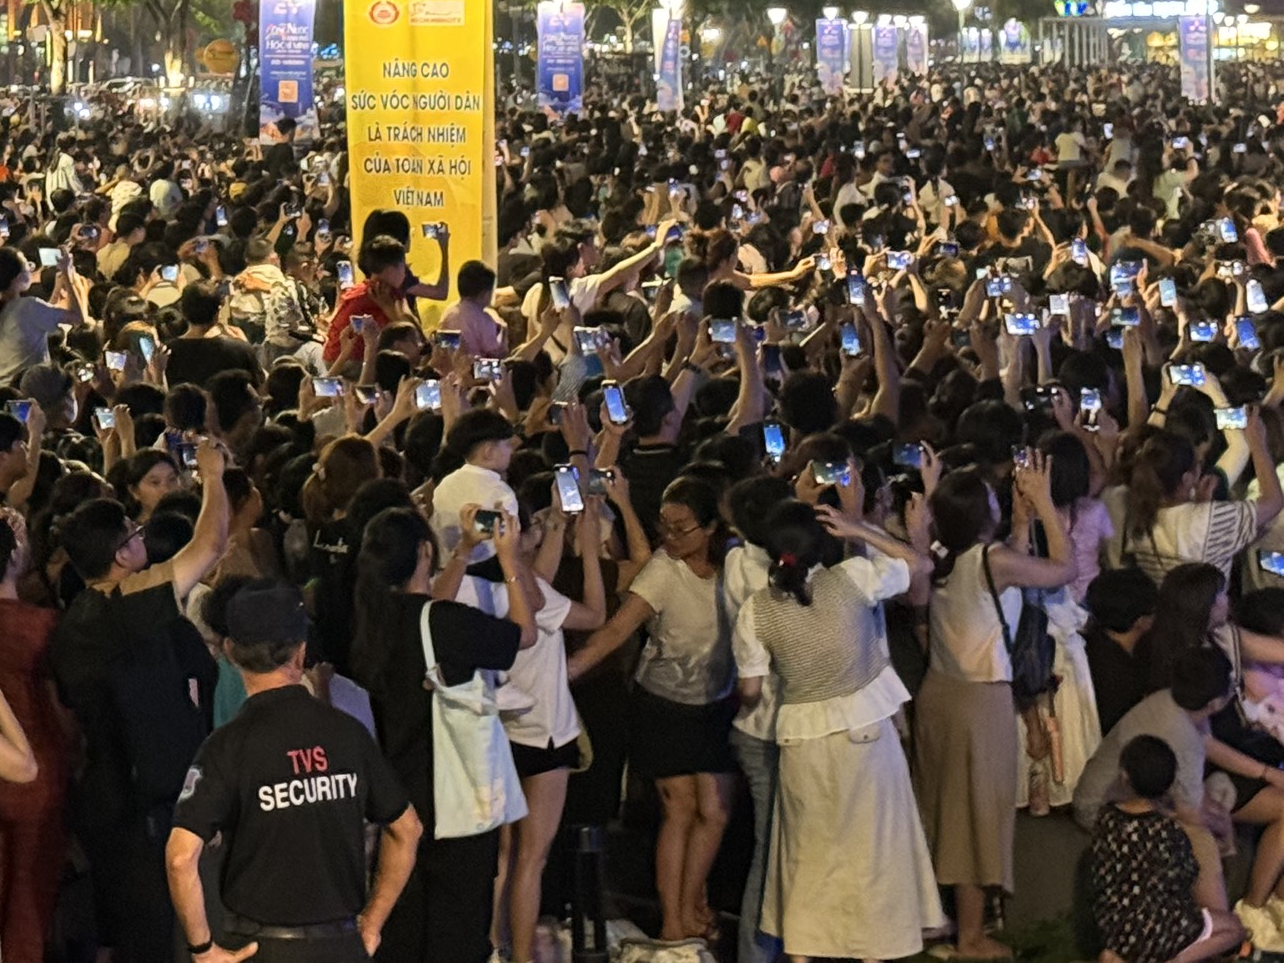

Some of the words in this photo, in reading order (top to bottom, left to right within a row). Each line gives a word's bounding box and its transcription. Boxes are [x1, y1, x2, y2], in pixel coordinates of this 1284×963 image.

[383, 58, 417, 78] NÂNG
[421, 62, 450, 78] CAO
[351, 90, 376, 110] SỨC
[380, 90, 410, 110] VÓC
[413, 90, 451, 110] NGƯỜI
[455, 91, 480, 110] DÂN
[368, 122, 382, 142] LÀ
[386, 122, 423, 143] TRÁCH
[427, 123, 466, 148] NHIỆM
[364, 152, 391, 173] CỦA
[395, 153, 423, 174] TOÀN
[427, 155, 445, 175] XÃ
[449, 156, 471, 180] HỘI
[394, 186, 415, 209] VIỆT
[417, 191, 444, 207] NAM
[286, 745, 328, 775] TVS
[258, 773, 357, 812] SECURITY
